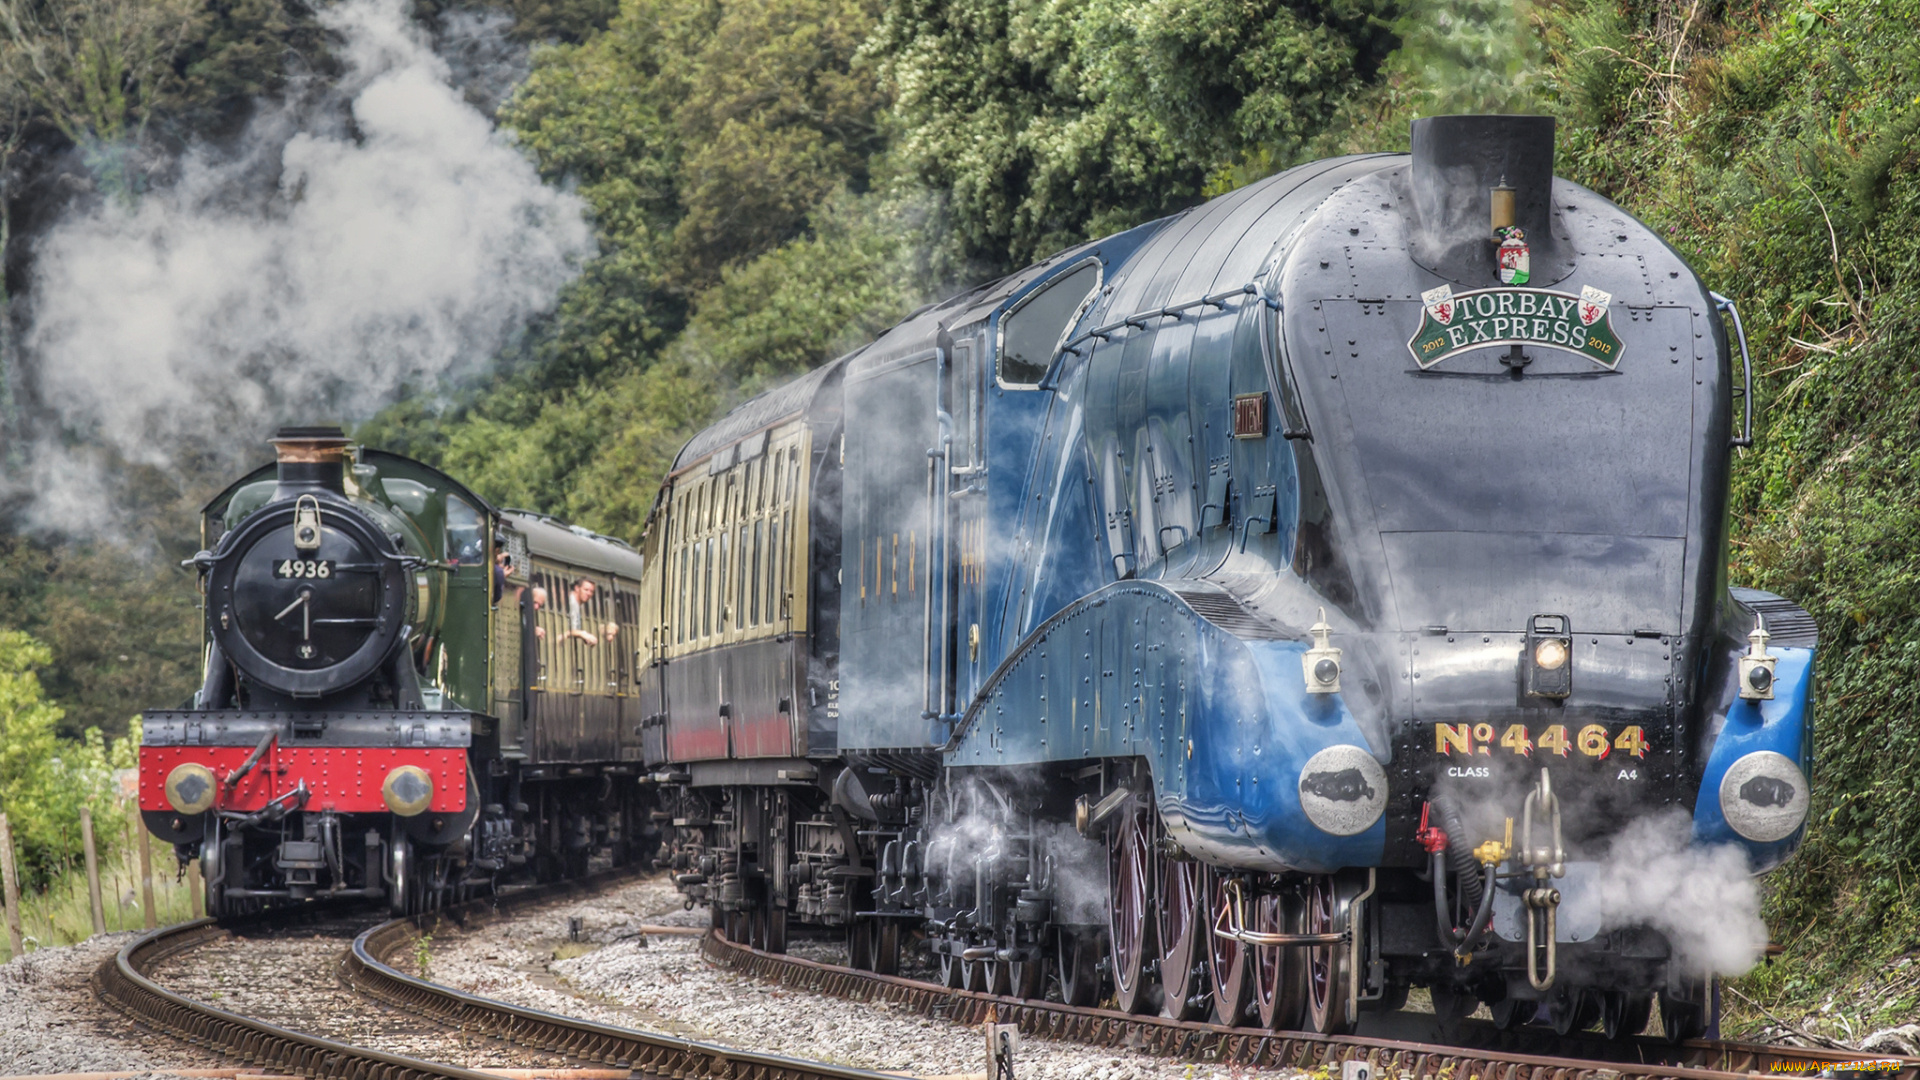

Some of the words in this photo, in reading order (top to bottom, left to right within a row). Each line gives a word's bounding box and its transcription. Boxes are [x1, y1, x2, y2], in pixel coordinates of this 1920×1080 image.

[1456, 292, 1578, 321] TORBAY
[1446, 317, 1588, 350] EXPRESS
[1422, 337, 1446, 353] 2012
[1588, 336, 1612, 355] 2012
[278, 559, 330, 579] 4936
[1500, 723, 1650, 760] 4464
[1448, 767, 1490, 778] CLASS
[1617, 769, 1638, 780] A4
